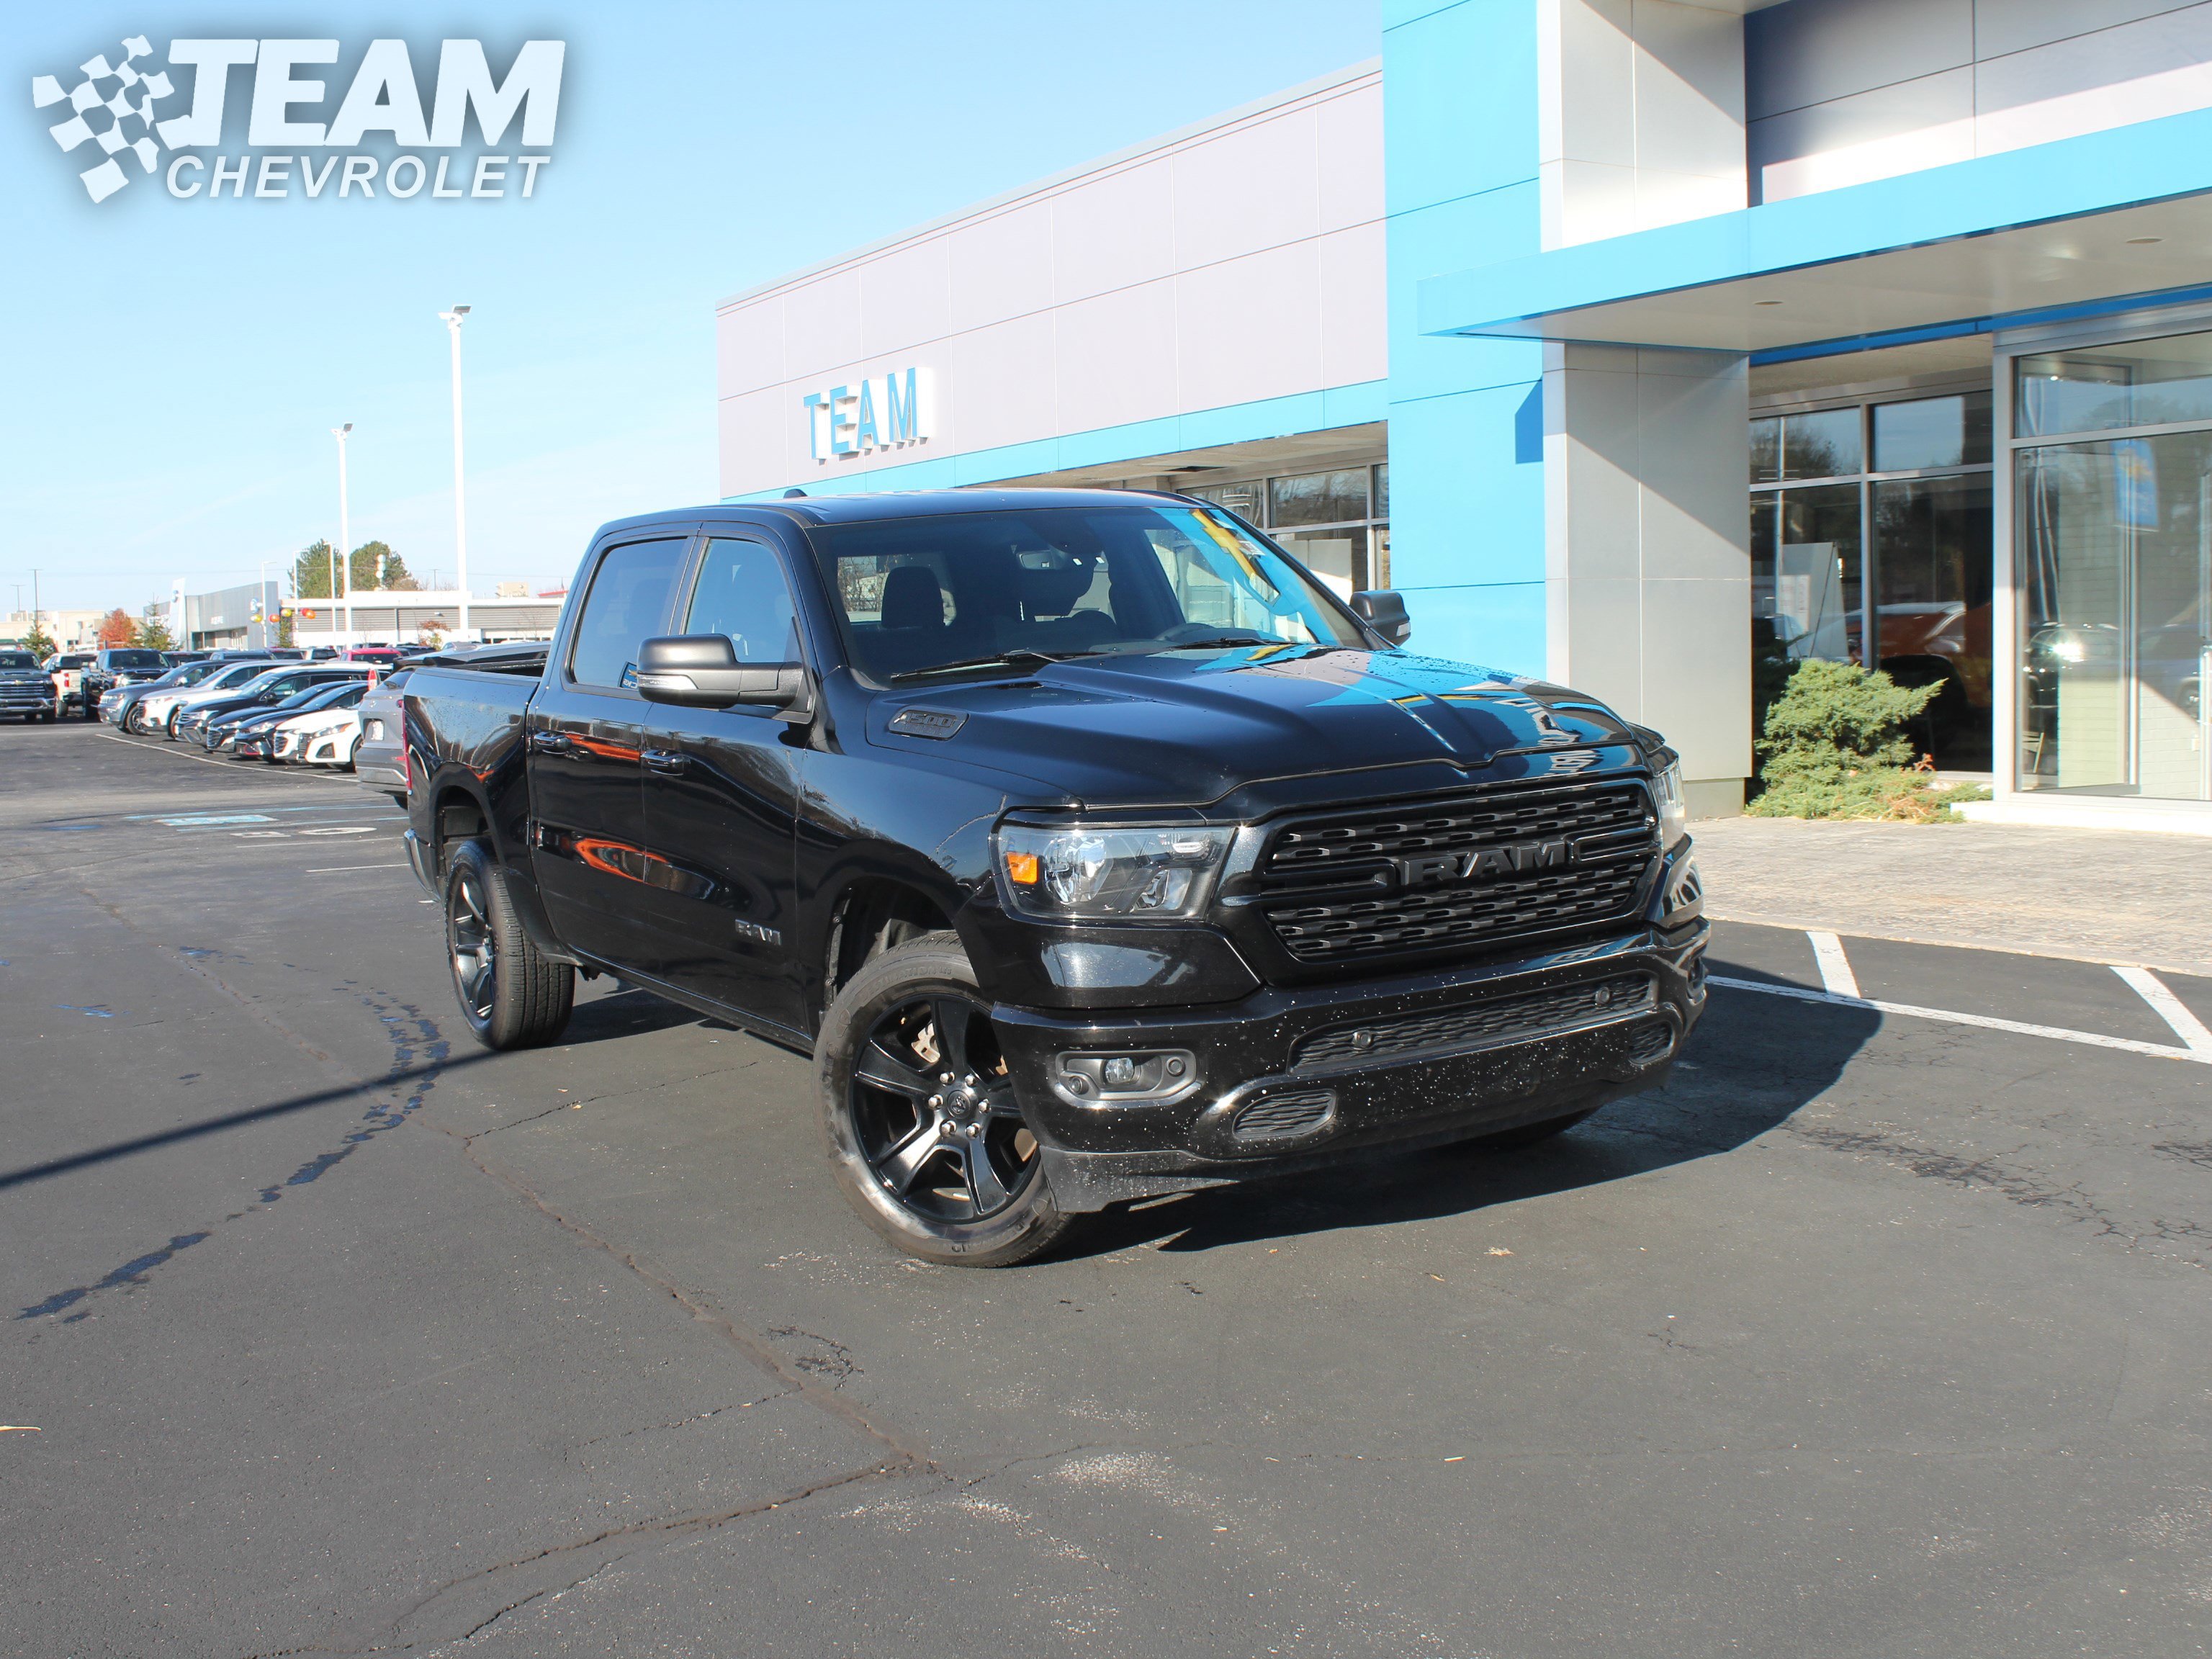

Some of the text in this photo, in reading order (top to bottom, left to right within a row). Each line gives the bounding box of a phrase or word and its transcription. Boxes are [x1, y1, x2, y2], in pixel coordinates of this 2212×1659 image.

[803, 367, 920, 461] TEAM
[1405, 840, 1565, 886] RAM
[735, 919, 781, 945] RAM
